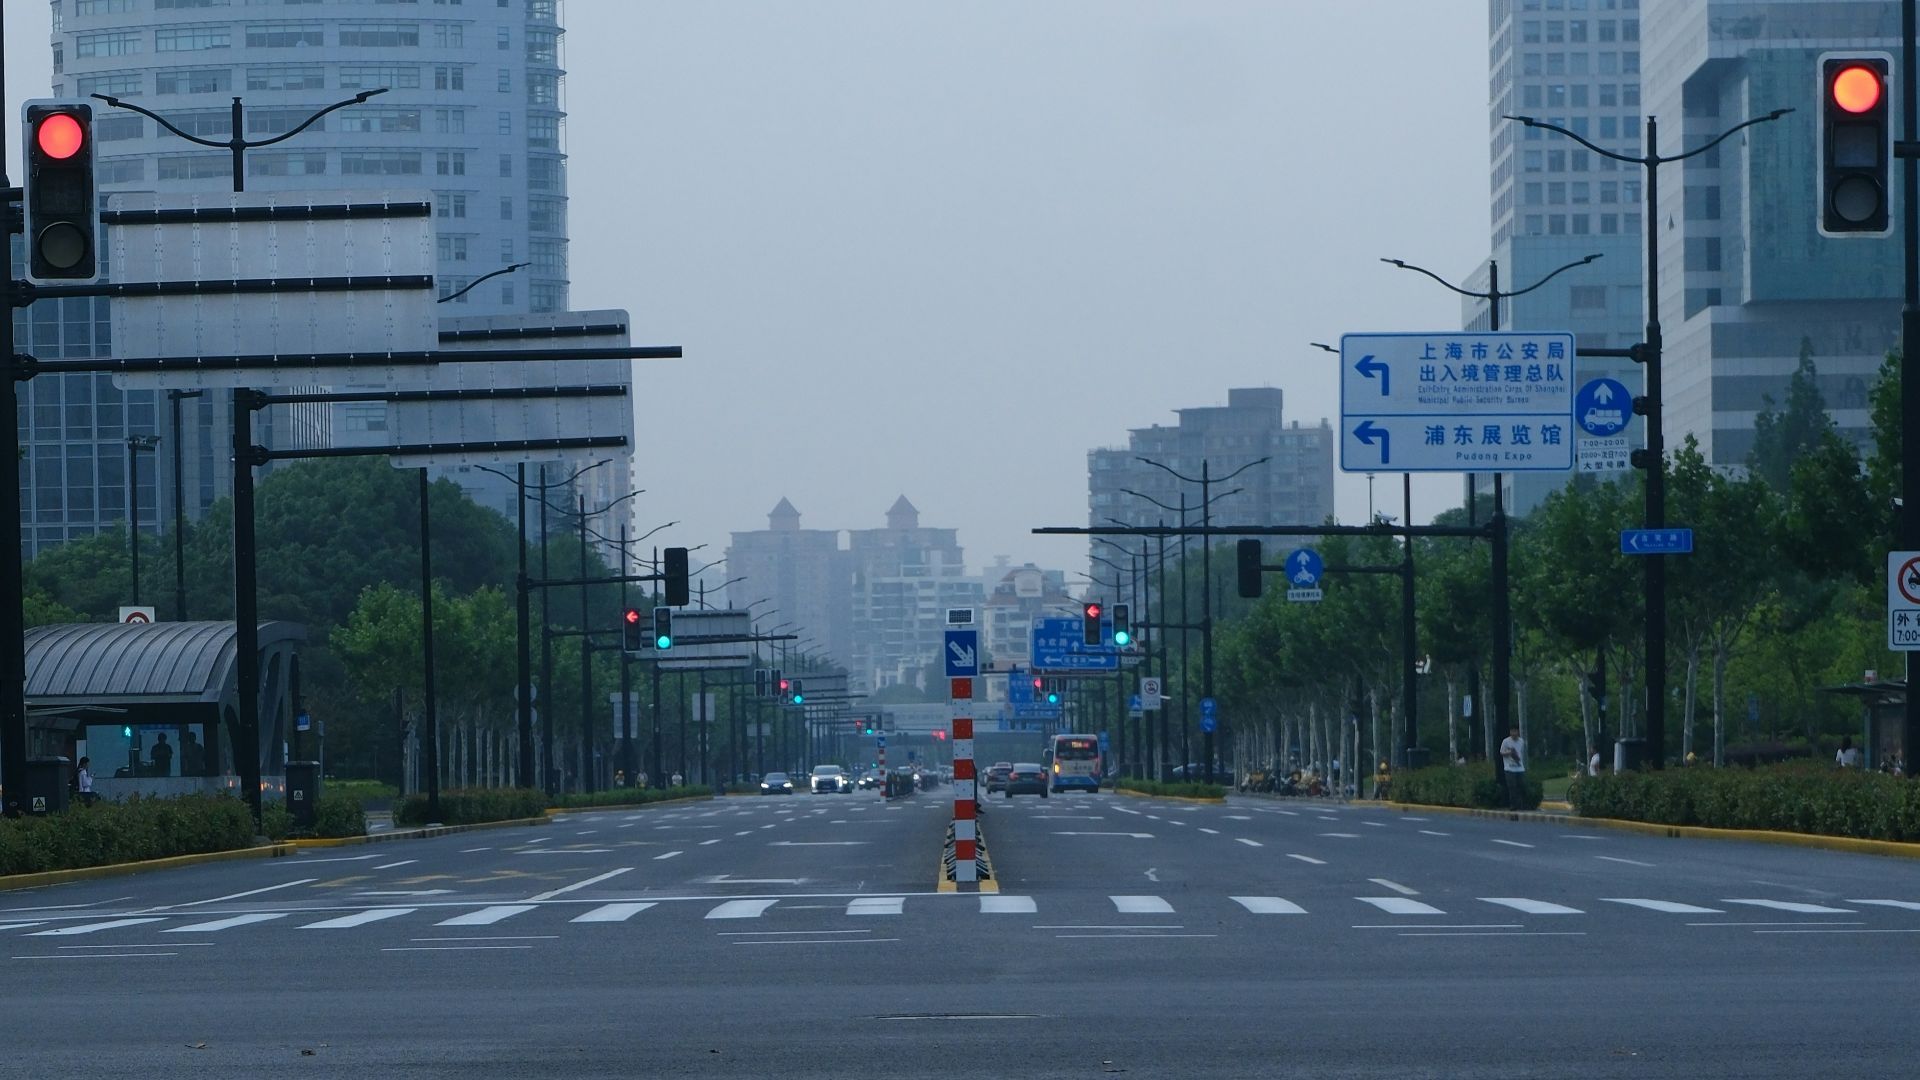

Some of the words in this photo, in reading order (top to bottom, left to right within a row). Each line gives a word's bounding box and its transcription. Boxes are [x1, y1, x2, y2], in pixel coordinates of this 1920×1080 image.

[1419, 342, 1564, 361] 上海市公安局
[1420, 364, 1564, 383] 出入境管理总队
[1535, 385, 1565, 394] Shanghai
[1425, 424, 1562, 446] 浦东展览馆
[1456, 452, 1498, 462] Pudong
[1505, 452, 1532, 461] Expo
